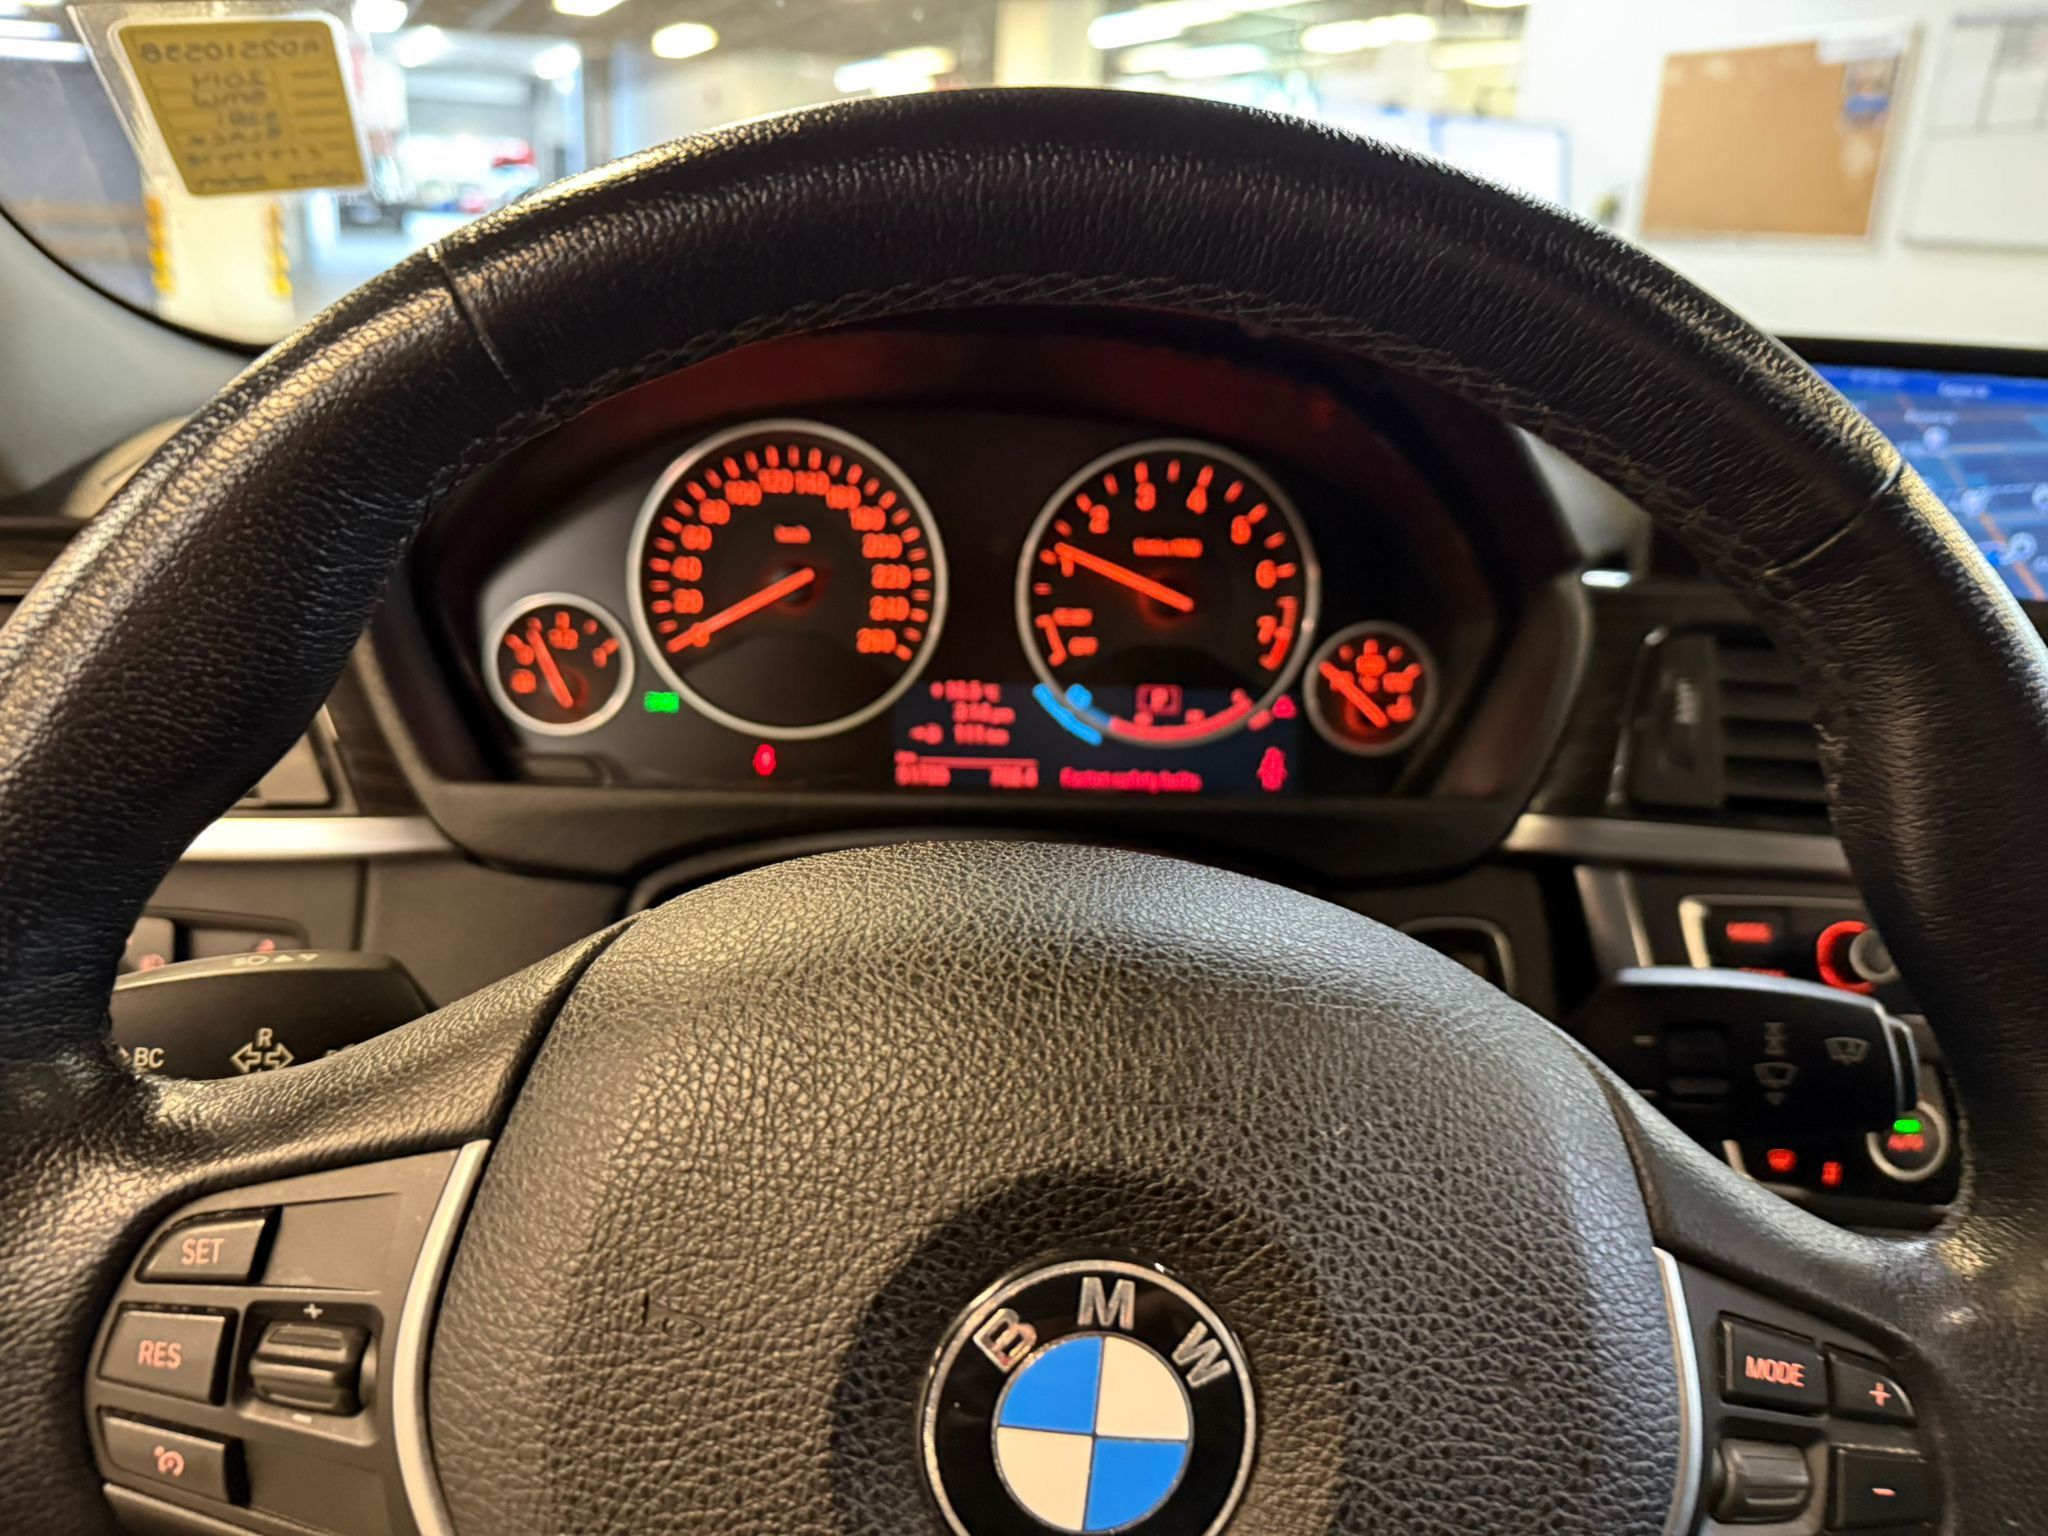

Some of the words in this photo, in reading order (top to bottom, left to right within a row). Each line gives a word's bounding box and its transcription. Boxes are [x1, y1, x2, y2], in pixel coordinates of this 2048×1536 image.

[257, 1027, 273, 1048] R
[133, 1047, 165, 1069] BC
[181, 1238, 225, 1265] SET
[973, 1276, 1231, 1389] BMW
[137, 1339, 182, 1369] RES
[1745, 1355, 1806, 1388] MODE
